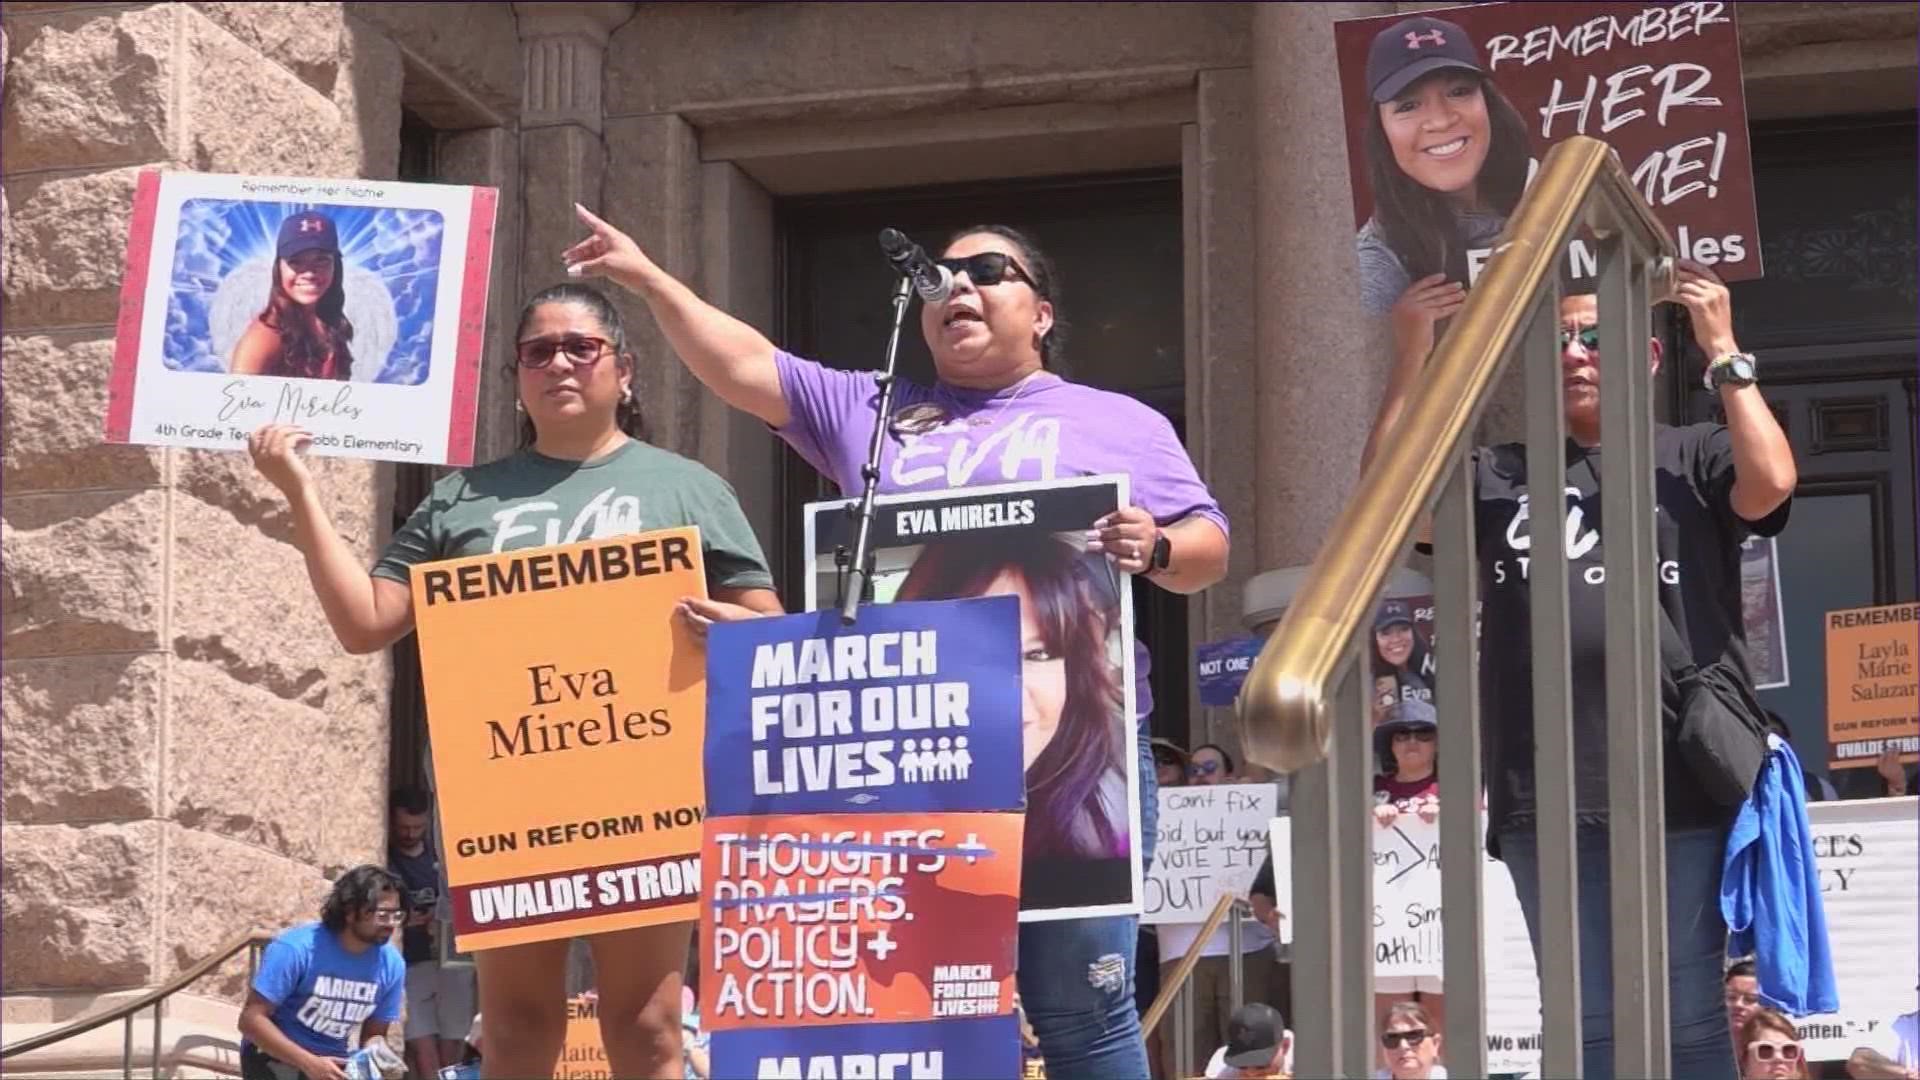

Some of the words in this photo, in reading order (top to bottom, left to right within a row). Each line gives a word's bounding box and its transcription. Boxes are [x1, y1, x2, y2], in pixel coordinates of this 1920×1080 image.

[1486, 2, 1730, 70] REMEMBER
[1539, 63, 1722, 138] HER
[242, 181, 313, 195] Remember
[318, 185, 341, 196] Her
[345, 186, 385, 198] Name
[1569, 225, 1746, 279] Mles
[218, 380, 264, 422] Eva
[273, 383, 362, 423] Mireles
[155, 424, 177, 437] 4th
[181, 425, 223, 440] Grade
[312, 434, 339, 447] obb
[343, 435, 423, 454] Elementary
[890, 411, 1061, 487] EVA
[897, 508, 937, 536] EVA
[941, 500, 1035, 531] MIRELES
[423, 537, 695, 606] REMEMBER
[751, 630, 937, 689] MARCH
[1200, 660, 1222, 676] NOT
[1226, 656, 1249, 672] ONE
[1859, 640, 1909, 663] Layla
[528, 664, 618, 706] Eva
[1402, 685, 1432, 701] Eva
[1851, 683, 1918, 702] Salazar
[751, 687, 853, 741] FOR
[861, 682, 970, 733] OUR
[1833, 721, 1858, 732] GUN
[1861, 717, 1907, 729] REFORM
[486, 703, 672, 761] Mireles
[1836, 740, 1885, 759] UVALDE
[753, 739, 895, 796] LIVES
[1225, 791, 1261, 813] fix
[456, 831, 517, 858] GUN
[528, 815, 644, 848] REFORM
[1195, 818, 1225, 843] but
[1812, 833, 1864, 858] CES
[714, 829, 947, 878] THOUGHTS
[1158, 846, 1210, 870] VOTE
[1220, 846, 1269, 868] IT
[470, 873, 591, 925] UVALDE
[597, 858, 701, 905] STRON
[713, 876, 915, 925] PRAYERS.
[1144, 876, 1211, 914] OUT
[714, 926, 858, 971] POLICY
[314, 976, 378, 1003] MARCH
[933, 964, 993, 982] MARCH
[933, 982, 965, 999] FOR
[966, 981, 1000, 998] OUR
[714, 972, 875, 1018] ACTION.
[933, 998, 979, 1016] LIVES
[1487, 1035, 1513, 1051] We
[1517, 1034, 1542, 1050] wil
